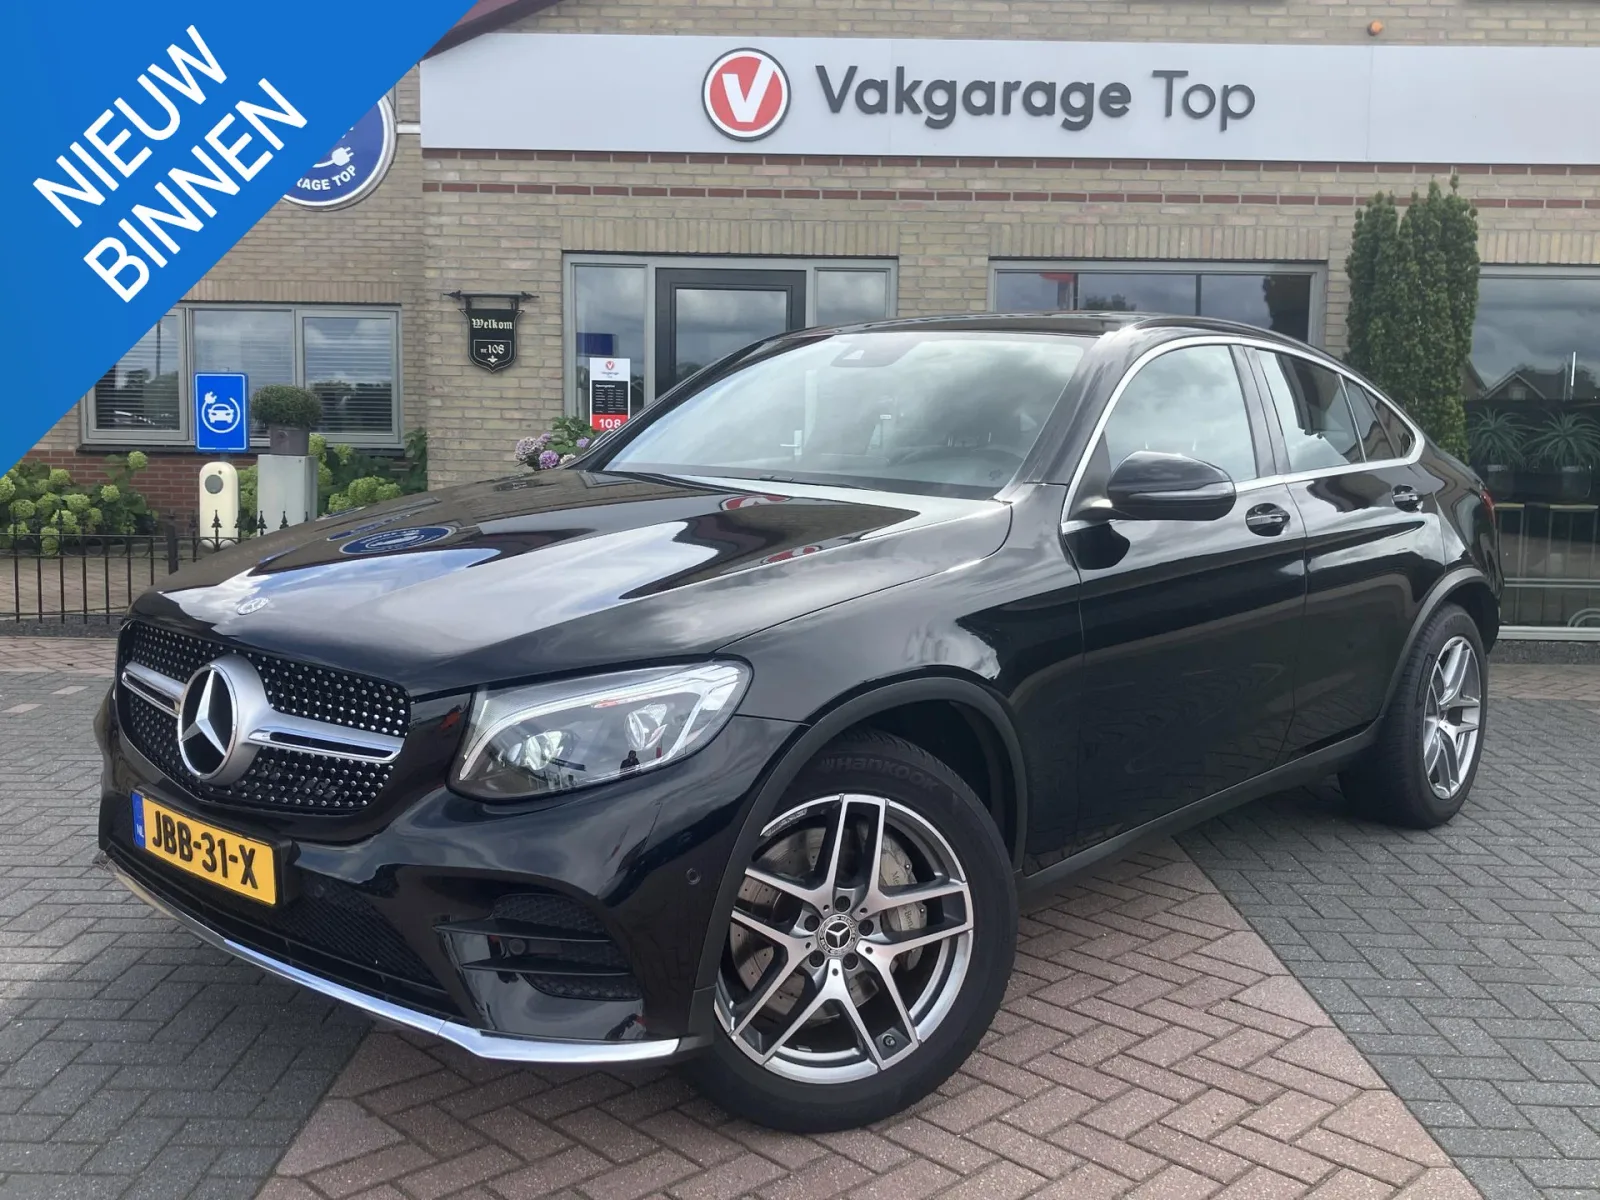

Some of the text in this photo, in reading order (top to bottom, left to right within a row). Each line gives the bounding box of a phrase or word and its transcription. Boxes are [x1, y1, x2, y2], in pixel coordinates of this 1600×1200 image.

[814, 65, 1255, 132] Vakgarage Top
[331, 164, 356, 187] TOP
[471, 318, 513, 330] Welkom
[488, 344, 505, 355] 108
[598, 418, 622, 430] 108
[152, 810, 259, 890] JBB-31-X
